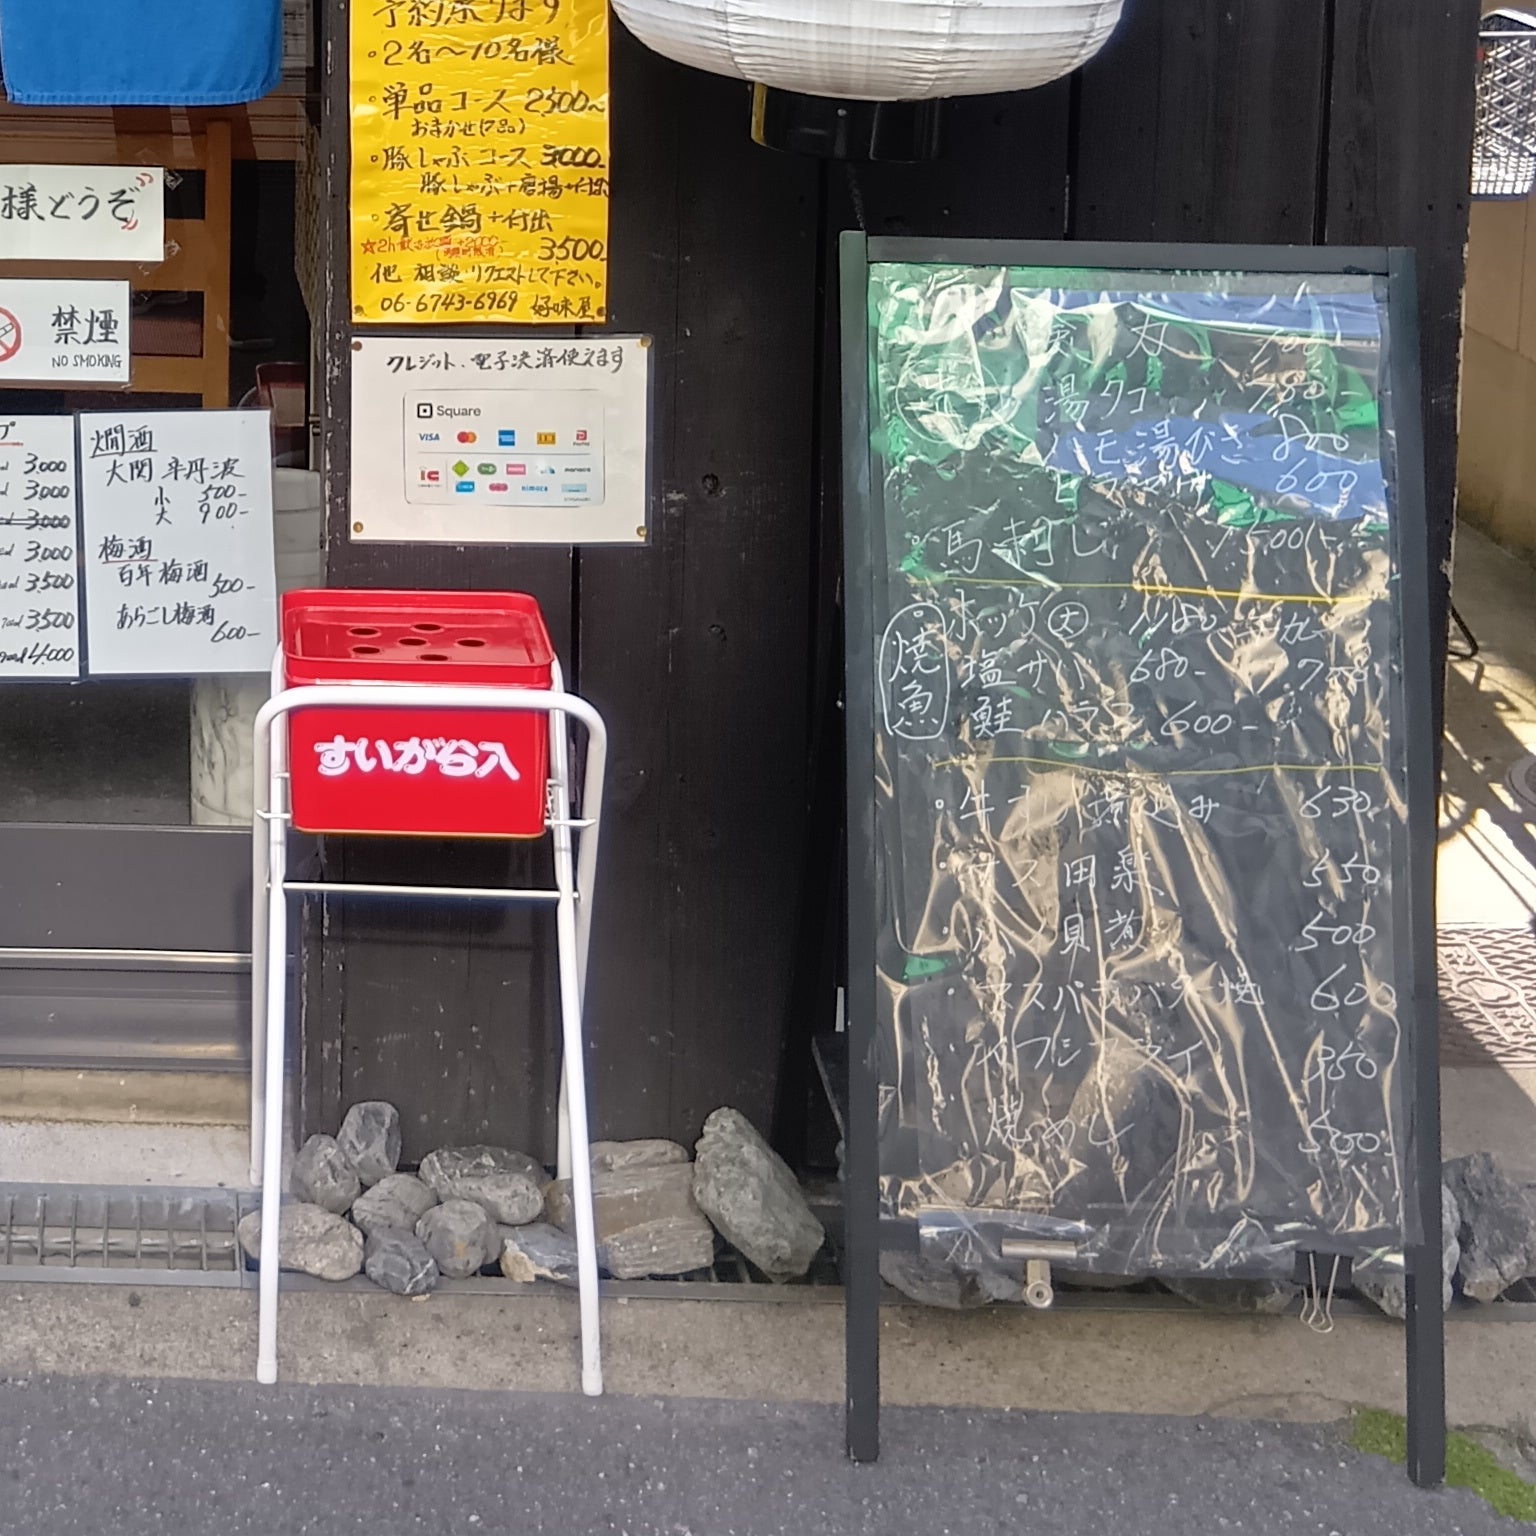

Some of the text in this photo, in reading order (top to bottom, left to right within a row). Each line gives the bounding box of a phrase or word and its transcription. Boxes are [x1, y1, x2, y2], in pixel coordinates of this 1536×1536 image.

[381, 293, 595, 320] 06-6743-6969 好味屋
[51, 304, 120, 345] 禁煙
[51, 355, 122, 369] NO SMOKING
[436, 405, 482, 418] Square
[419, 433, 440, 441] VISA
[154, 486, 171, 505] 小
[155, 507, 172, 525] 大
[98, 534, 152, 561] 梅酒
[118, 559, 208, 587] 百年梅酒
[116, 602, 215, 629] あらごし梅酒
[314, 734, 520, 780] すいがら入
